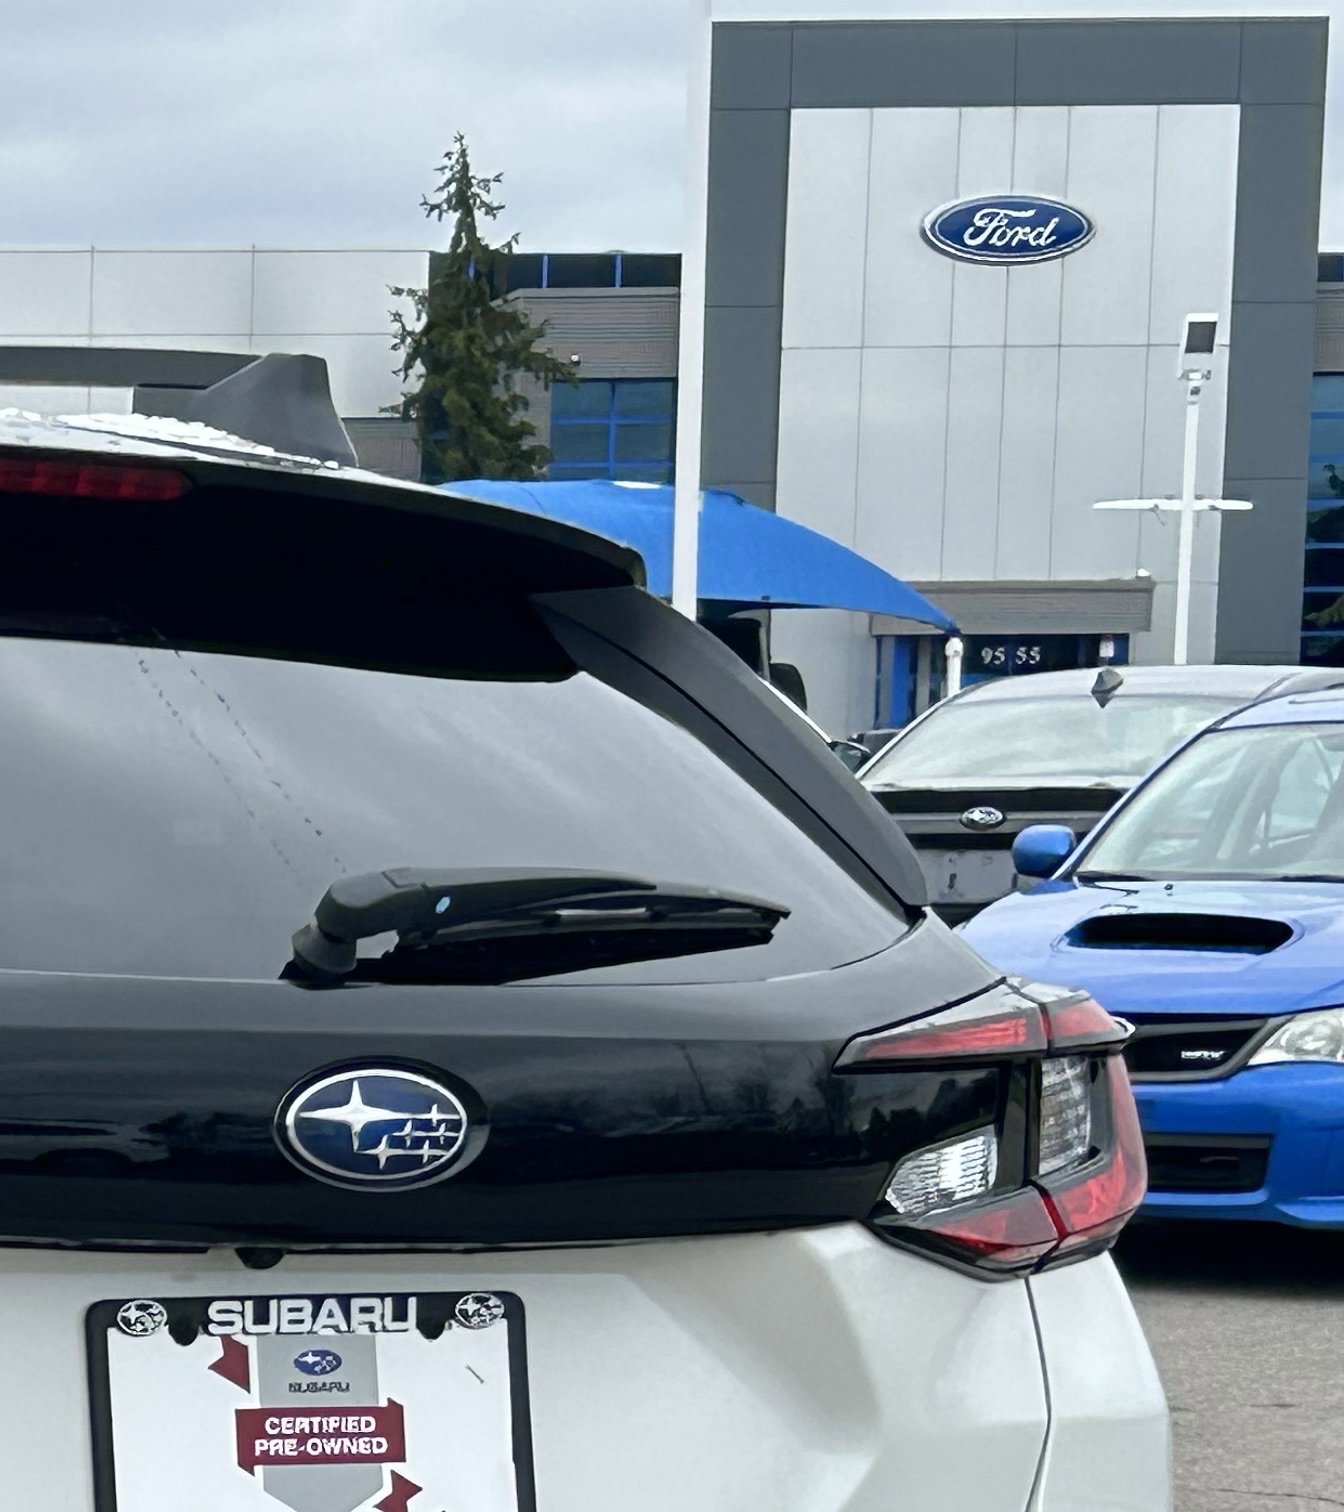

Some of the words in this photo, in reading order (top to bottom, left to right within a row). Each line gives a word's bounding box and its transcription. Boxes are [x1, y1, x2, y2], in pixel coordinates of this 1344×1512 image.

[963, 208, 1060, 247] Ford
[206, 1296, 418, 1335] SUBARU
[288, 1381, 351, 1393] SUBARU
[265, 1416, 377, 1435] CERTIFIED
[254, 1436, 389, 1457] PRE-OWNED
